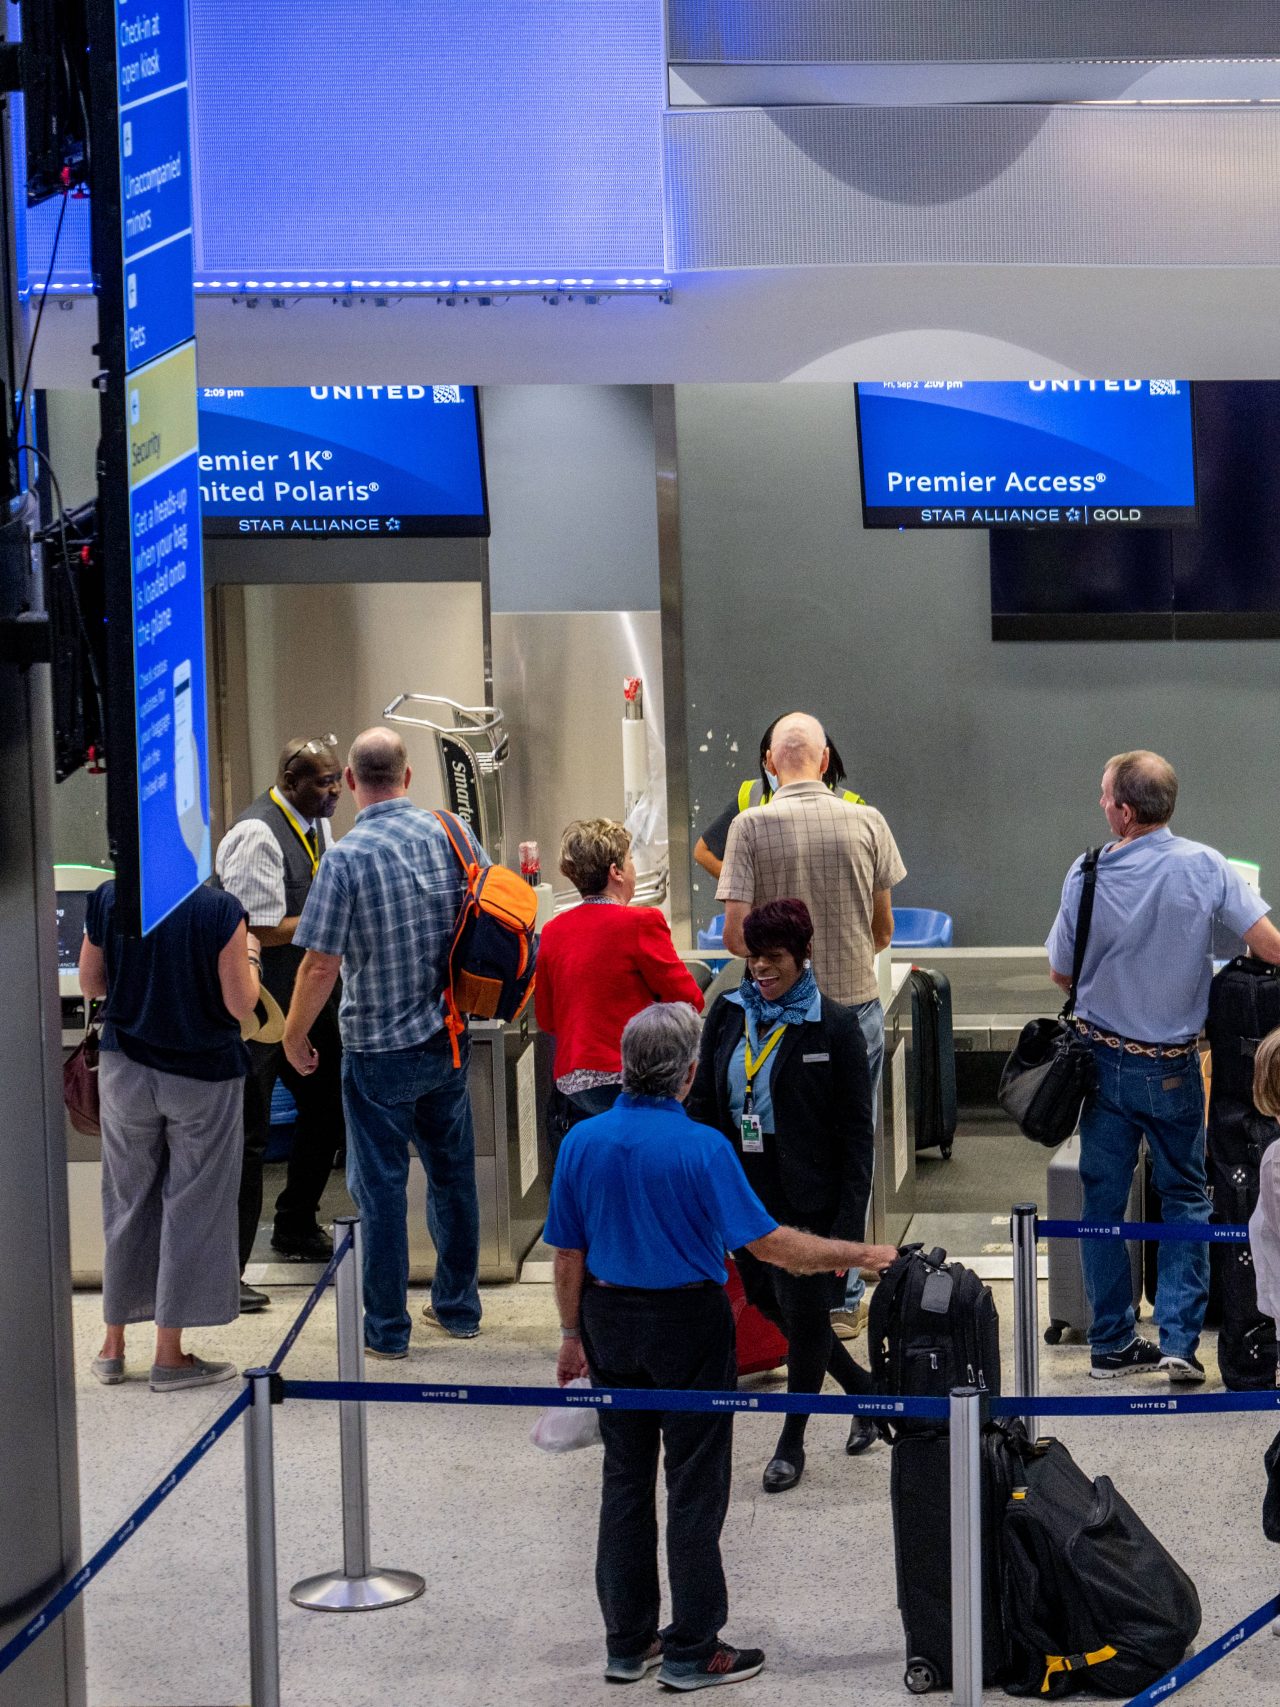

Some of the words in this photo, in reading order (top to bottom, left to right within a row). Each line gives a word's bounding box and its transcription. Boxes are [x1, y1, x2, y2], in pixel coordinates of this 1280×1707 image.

[120, 15, 150, 46] Check-in
[152, 12, 160, 36] at
[122, 62, 140, 92] open
[141, 48, 160, 78] kiosk
[125, 151, 180, 199] Unaccompanied
[126, 209, 152, 238] minors
[130, 325, 146, 350] Pets
[204, 388, 224, 397] 2:09
[227, 390, 244, 398] pm
[310, 386, 425, 400] UNITED
[946, 380, 962, 390] pm
[1028, 380, 1142, 391] UNITED
[132, 431, 161, 467] Security
[198, 451, 278, 470] emier
[198, 481, 264, 502] nited
[888, 472, 996, 492] Premier
[134, 510, 148, 537] Get
[148, 510, 153, 528] a
[154, 488, 187, 526] heads-up
[239, 519, 284, 531] STAR
[290, 519, 380, 531] ALLIANCE
[921, 510, 966, 522] STAR
[972, 510, 1059, 522] ALLIANCE
[1094, 509, 1140, 521] GOLD
[136, 546, 156, 574] when
[156, 533, 173, 568] your
[173, 523, 188, 550] bag
[136, 586, 143, 611] is
[143, 566, 168, 604] loaded
[169, 560, 186, 588] onto
[138, 620, 150, 647] the
[151, 608, 172, 645] plane
